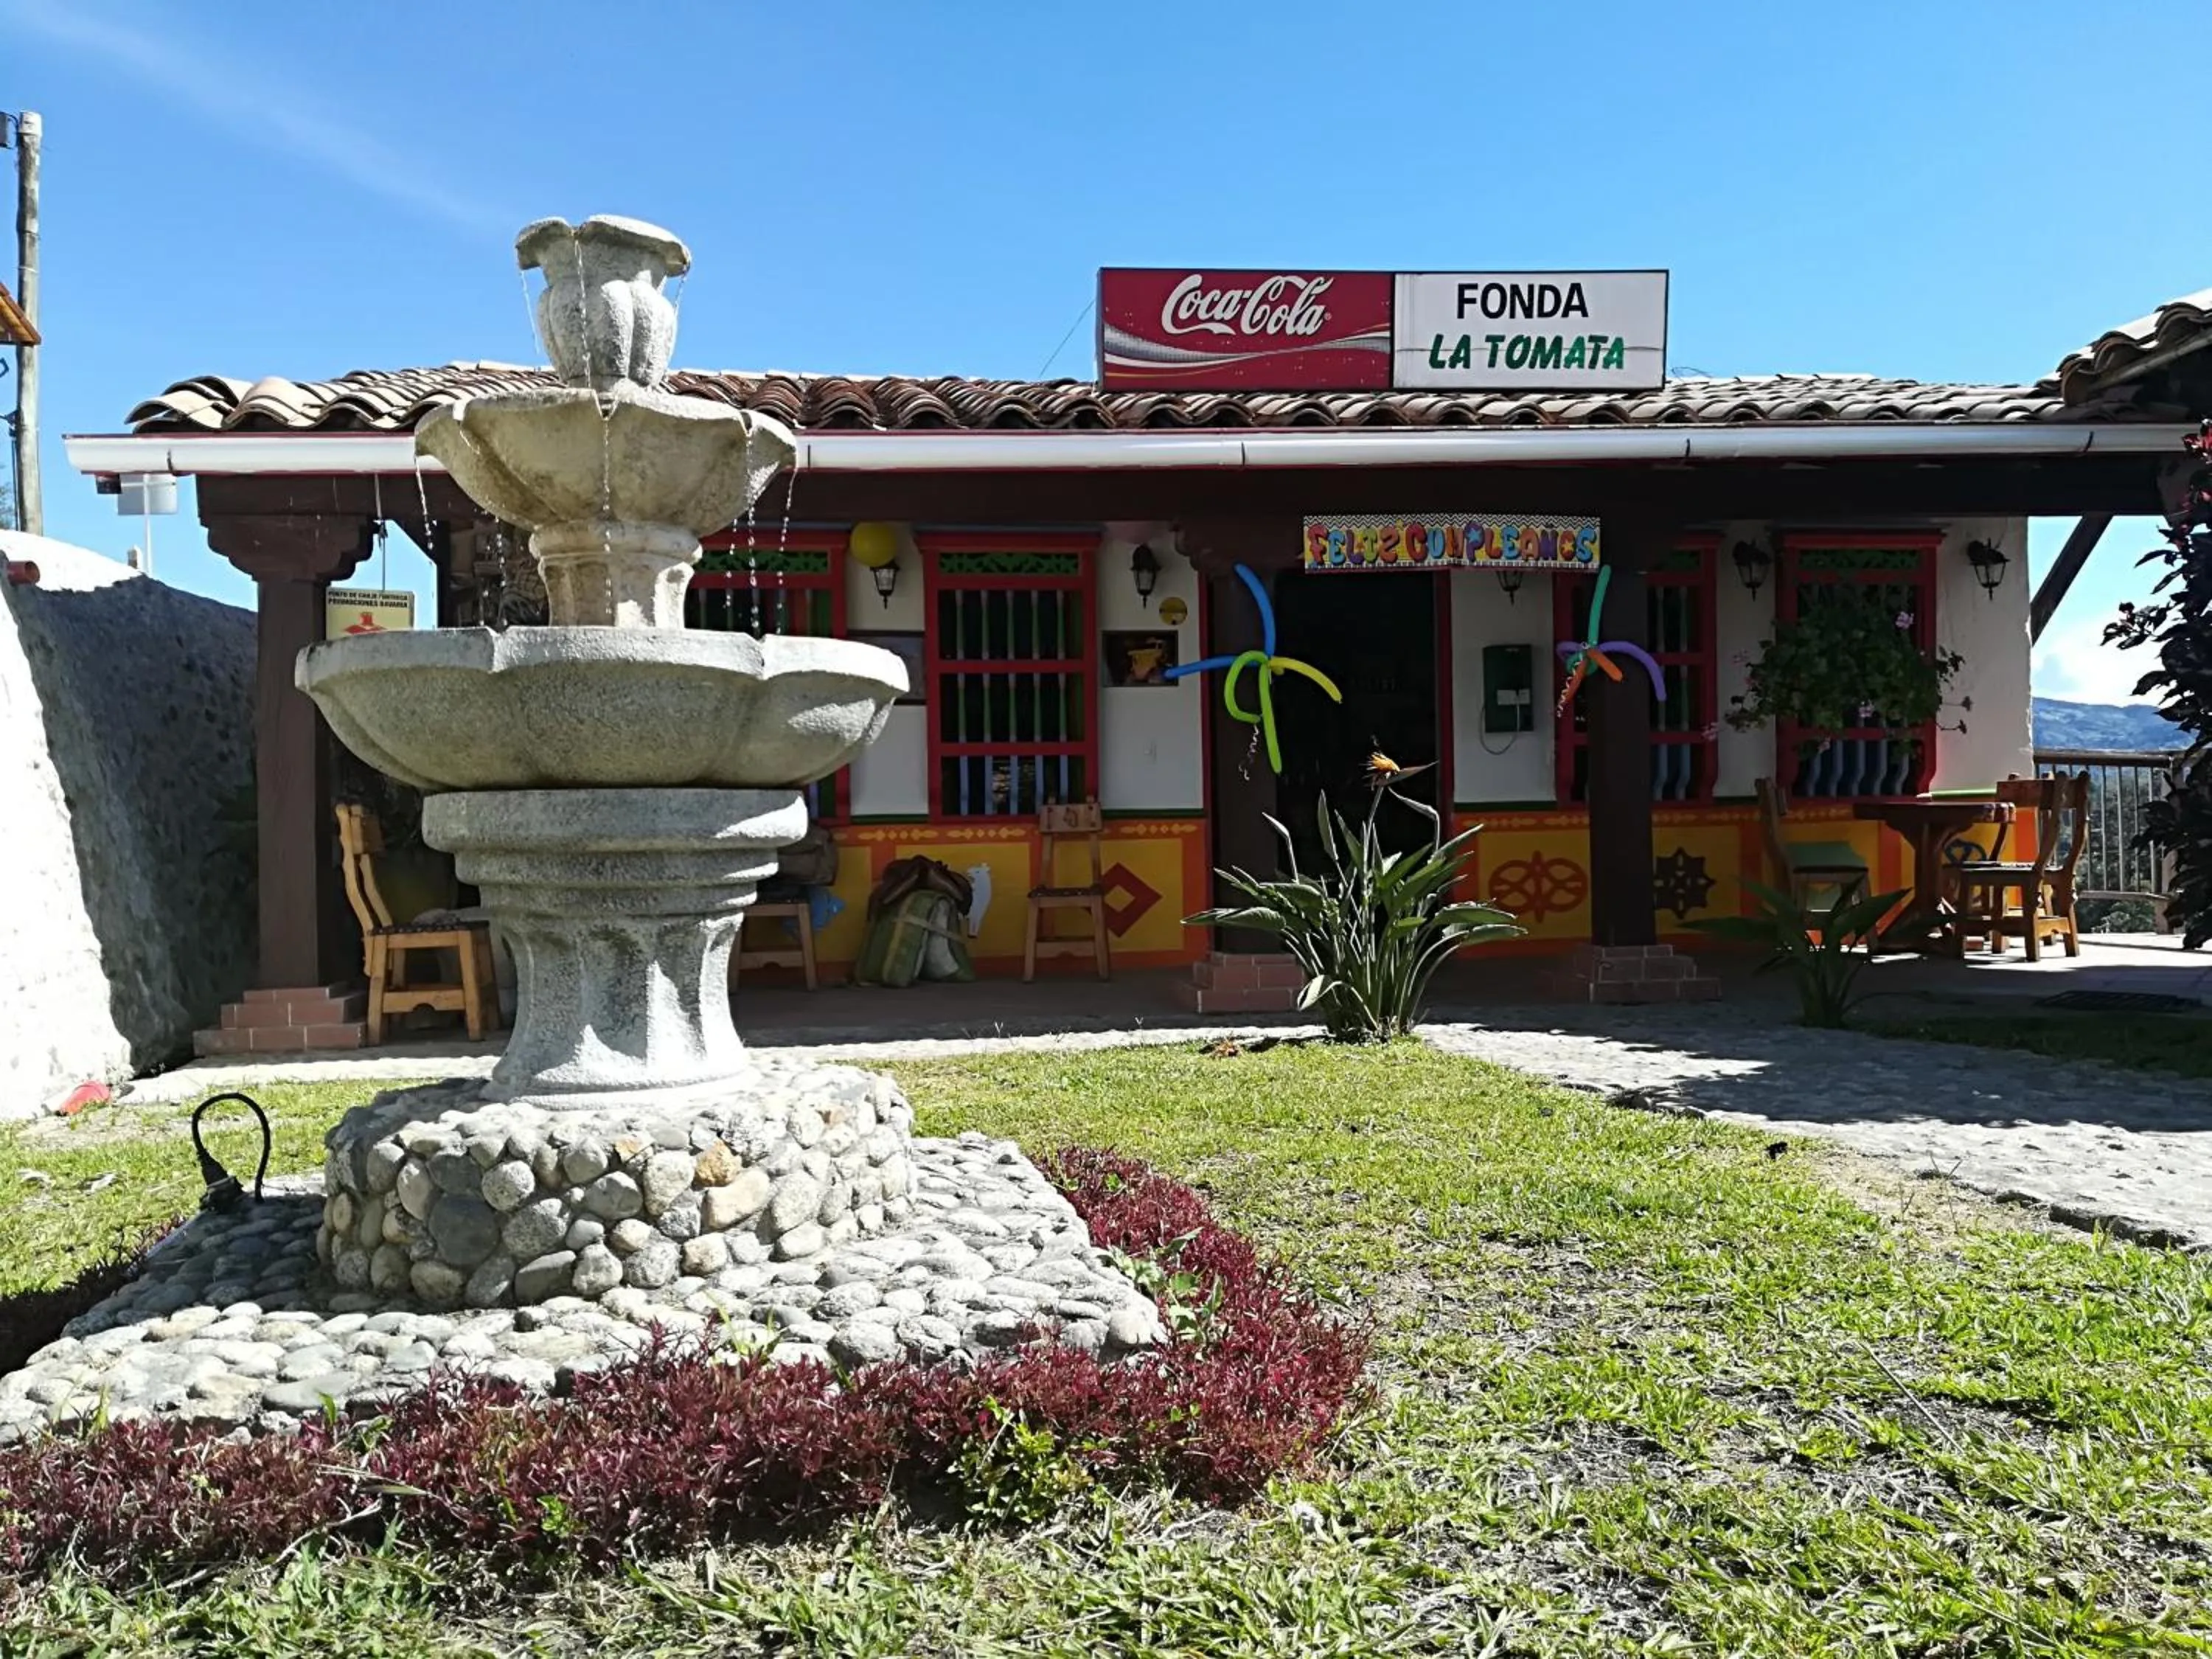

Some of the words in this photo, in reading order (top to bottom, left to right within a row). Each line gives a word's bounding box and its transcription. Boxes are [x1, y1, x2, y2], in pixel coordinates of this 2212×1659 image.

[1161, 274, 1334, 335] Coca-Cola
[1456, 282, 1589, 319] FONDA
[1428, 333, 1471, 369] LA
[1484, 334, 1624, 369] TOMATA
[1307, 524, 1399, 566] FELIZ
